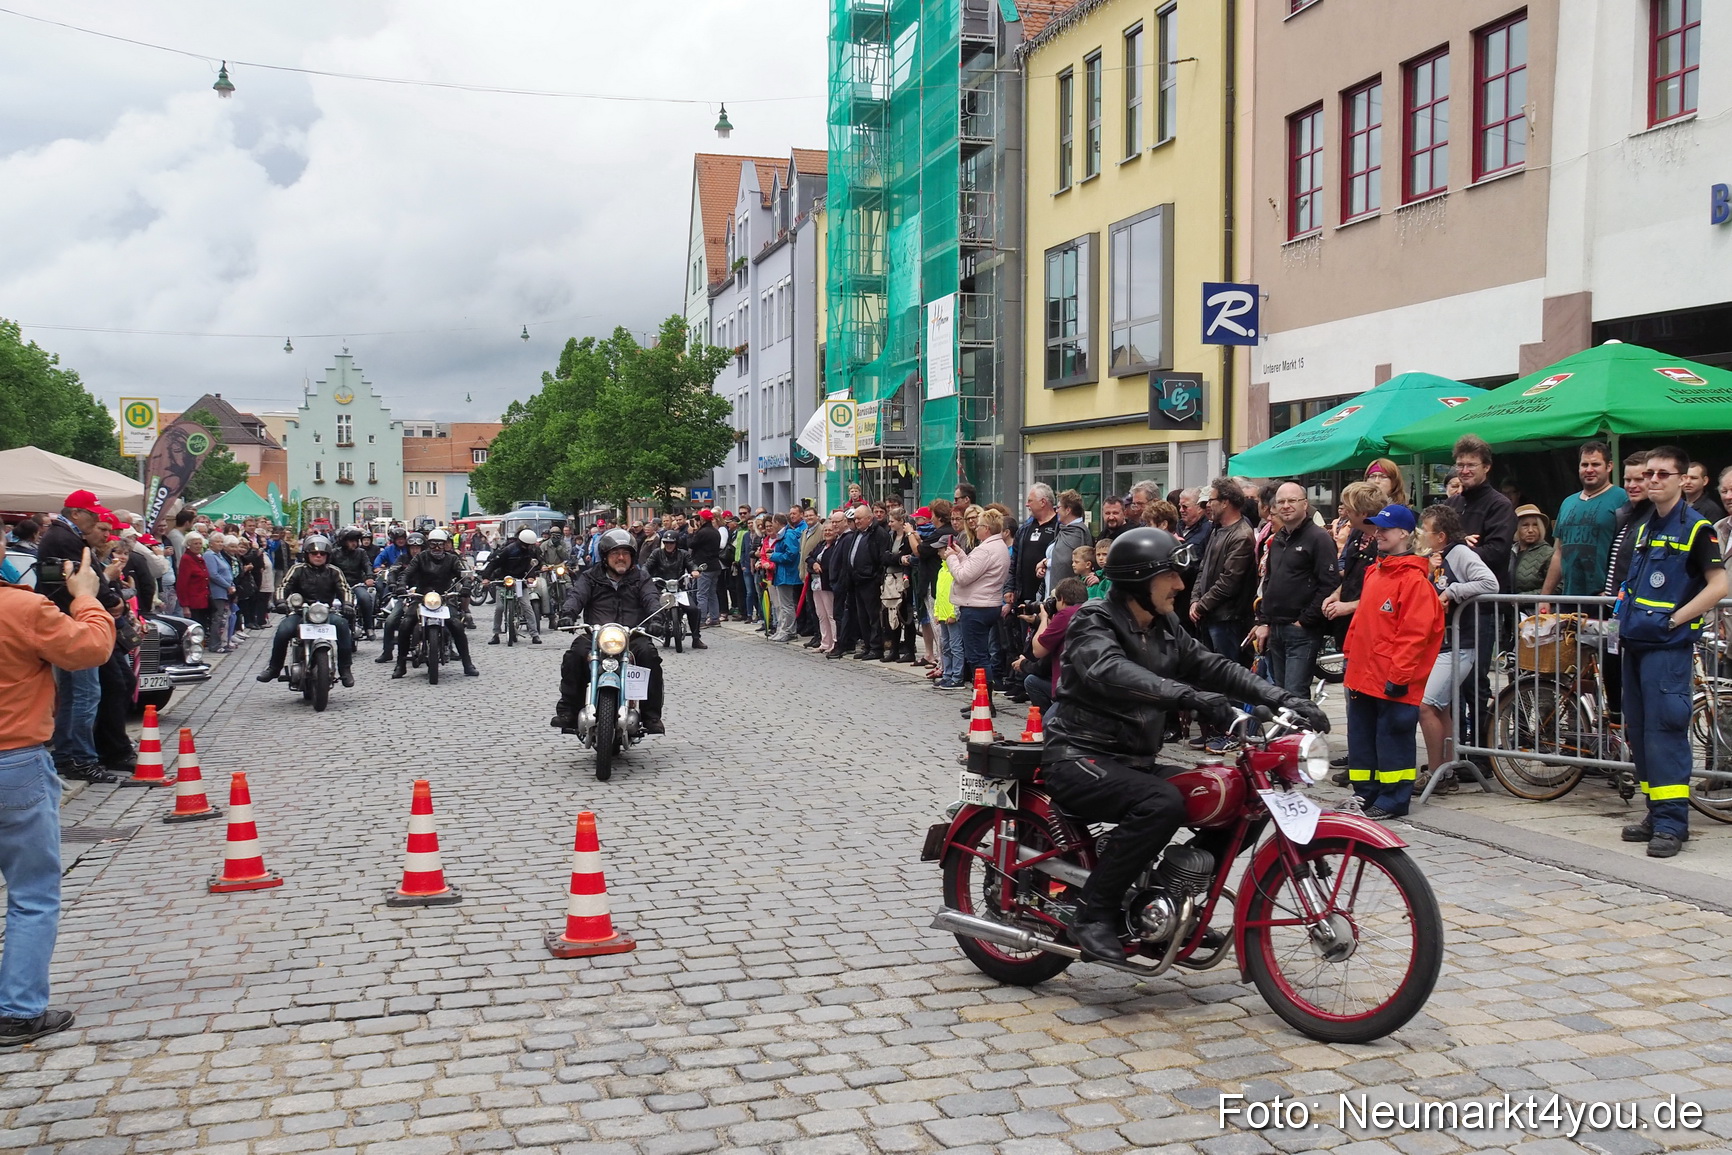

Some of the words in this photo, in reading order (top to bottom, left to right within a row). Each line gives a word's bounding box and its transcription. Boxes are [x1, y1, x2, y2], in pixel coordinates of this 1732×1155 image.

[1711, 183, 1729, 225] B
[1263, 363, 1281, 375] Unterer
[1282, 359, 1297, 372] Markt
[1298, 357, 1305, 369] 15
[1171, 387, 1190, 411] G2
[132, 407, 146, 422] H
[836, 408, 846, 422] H
[150, 677, 167, 687] 272H
[627, 671, 640, 679] 400
[962, 774, 988, 790] Express-
[961, 788, 984, 802] Treffen
